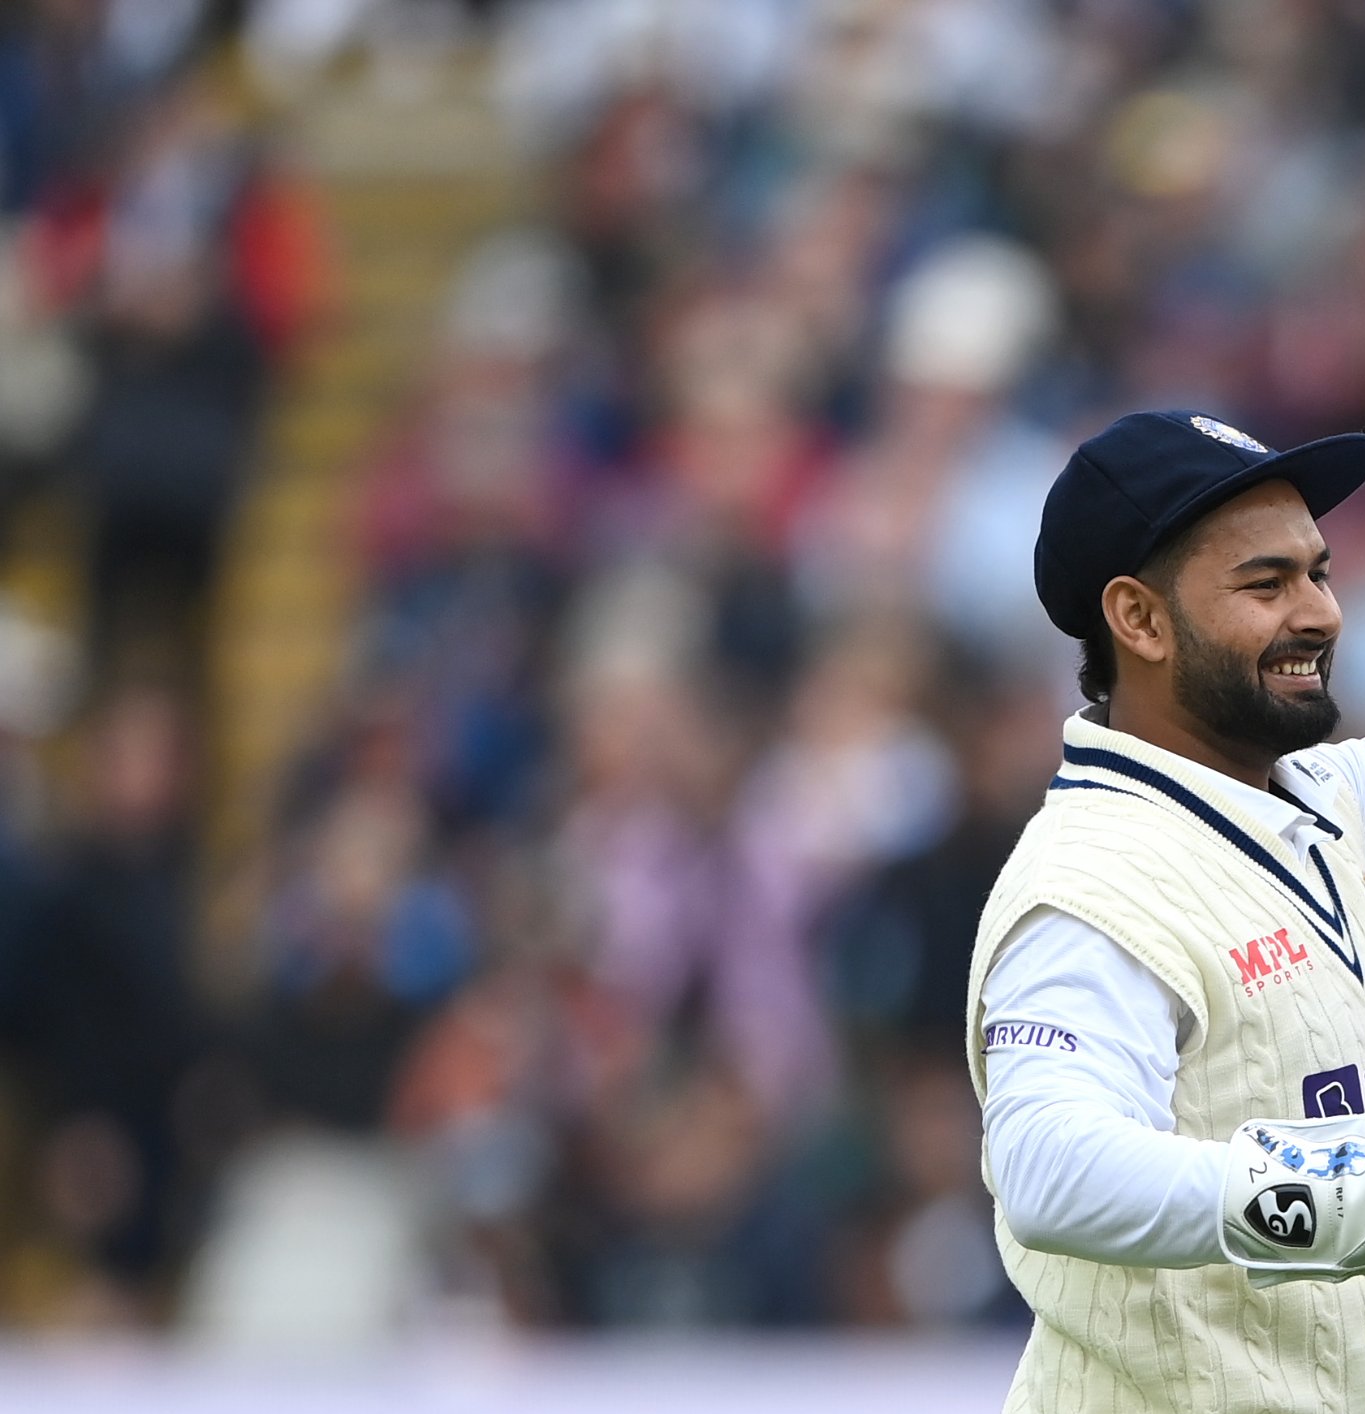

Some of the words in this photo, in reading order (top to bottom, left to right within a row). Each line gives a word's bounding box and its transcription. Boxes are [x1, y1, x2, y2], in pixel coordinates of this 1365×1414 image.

[1229, 928, 1308, 985] MPL
[1244, 960, 1314, 998] SPORTS
[996, 1025, 1078, 1052] BYJU'S
